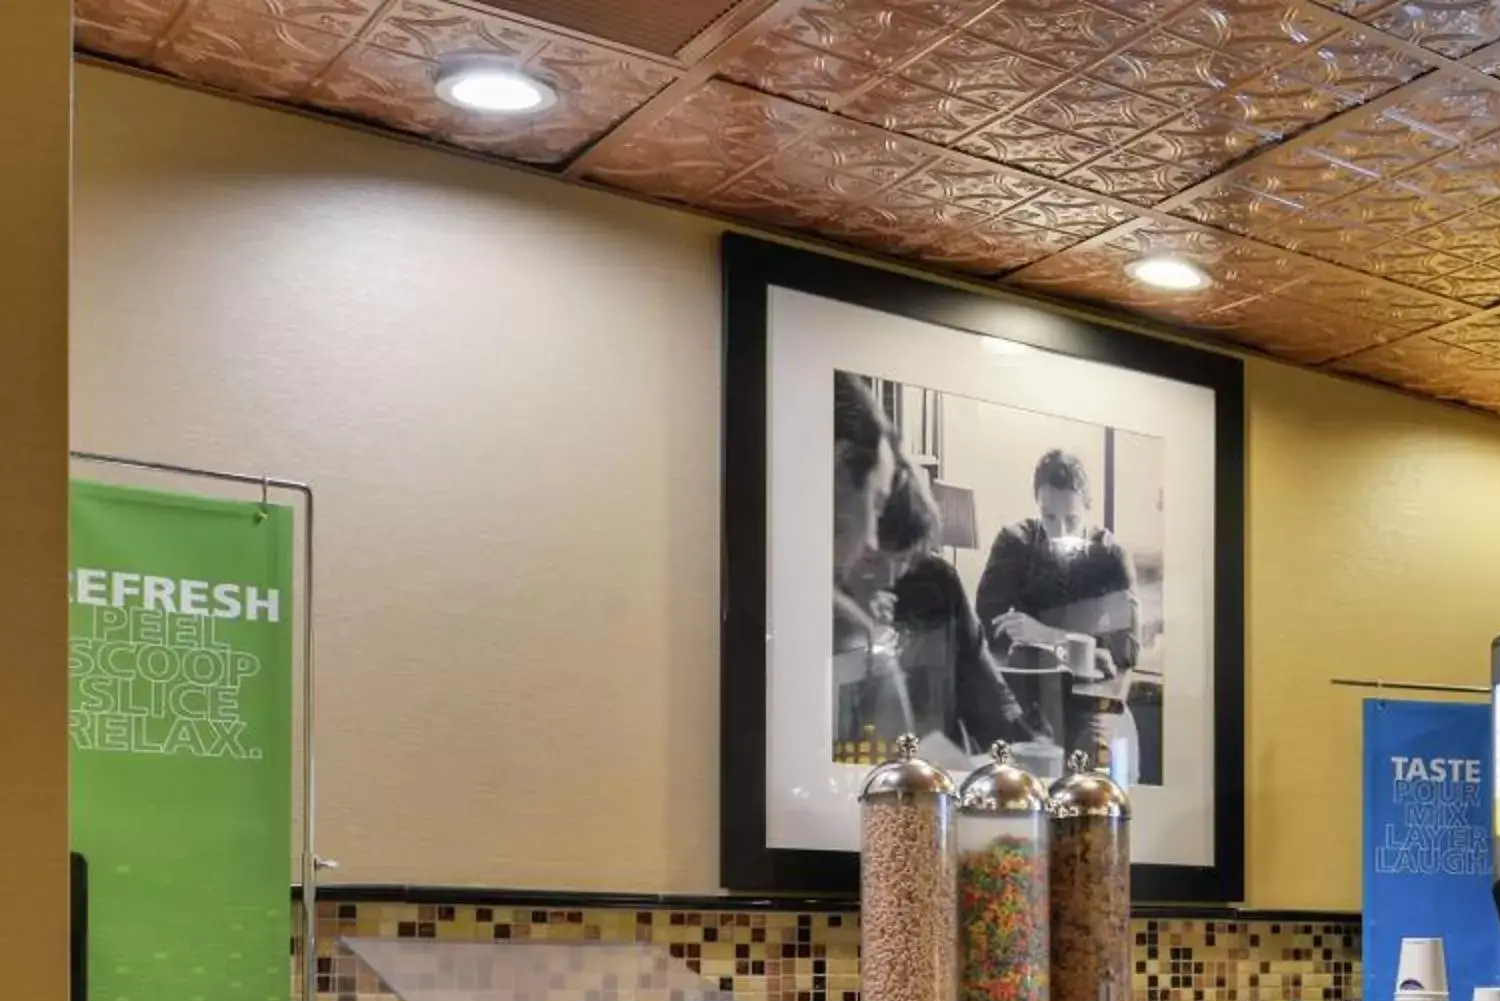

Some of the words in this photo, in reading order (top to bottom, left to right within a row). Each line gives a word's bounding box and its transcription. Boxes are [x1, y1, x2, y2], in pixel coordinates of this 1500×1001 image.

[68, 566, 280, 622] EFRESH
[93, 604, 229, 650] PEEL
[68, 637, 261, 688] SCOOP
[79, 675, 239, 721] SLICE
[68, 710, 263, 759] RELAX.
[1391, 756, 1481, 783] TASTE
[1393, 779, 1481, 806] POUR
[1403, 802, 1470, 828] MIX
[1385, 822, 1489, 857] LAYER
